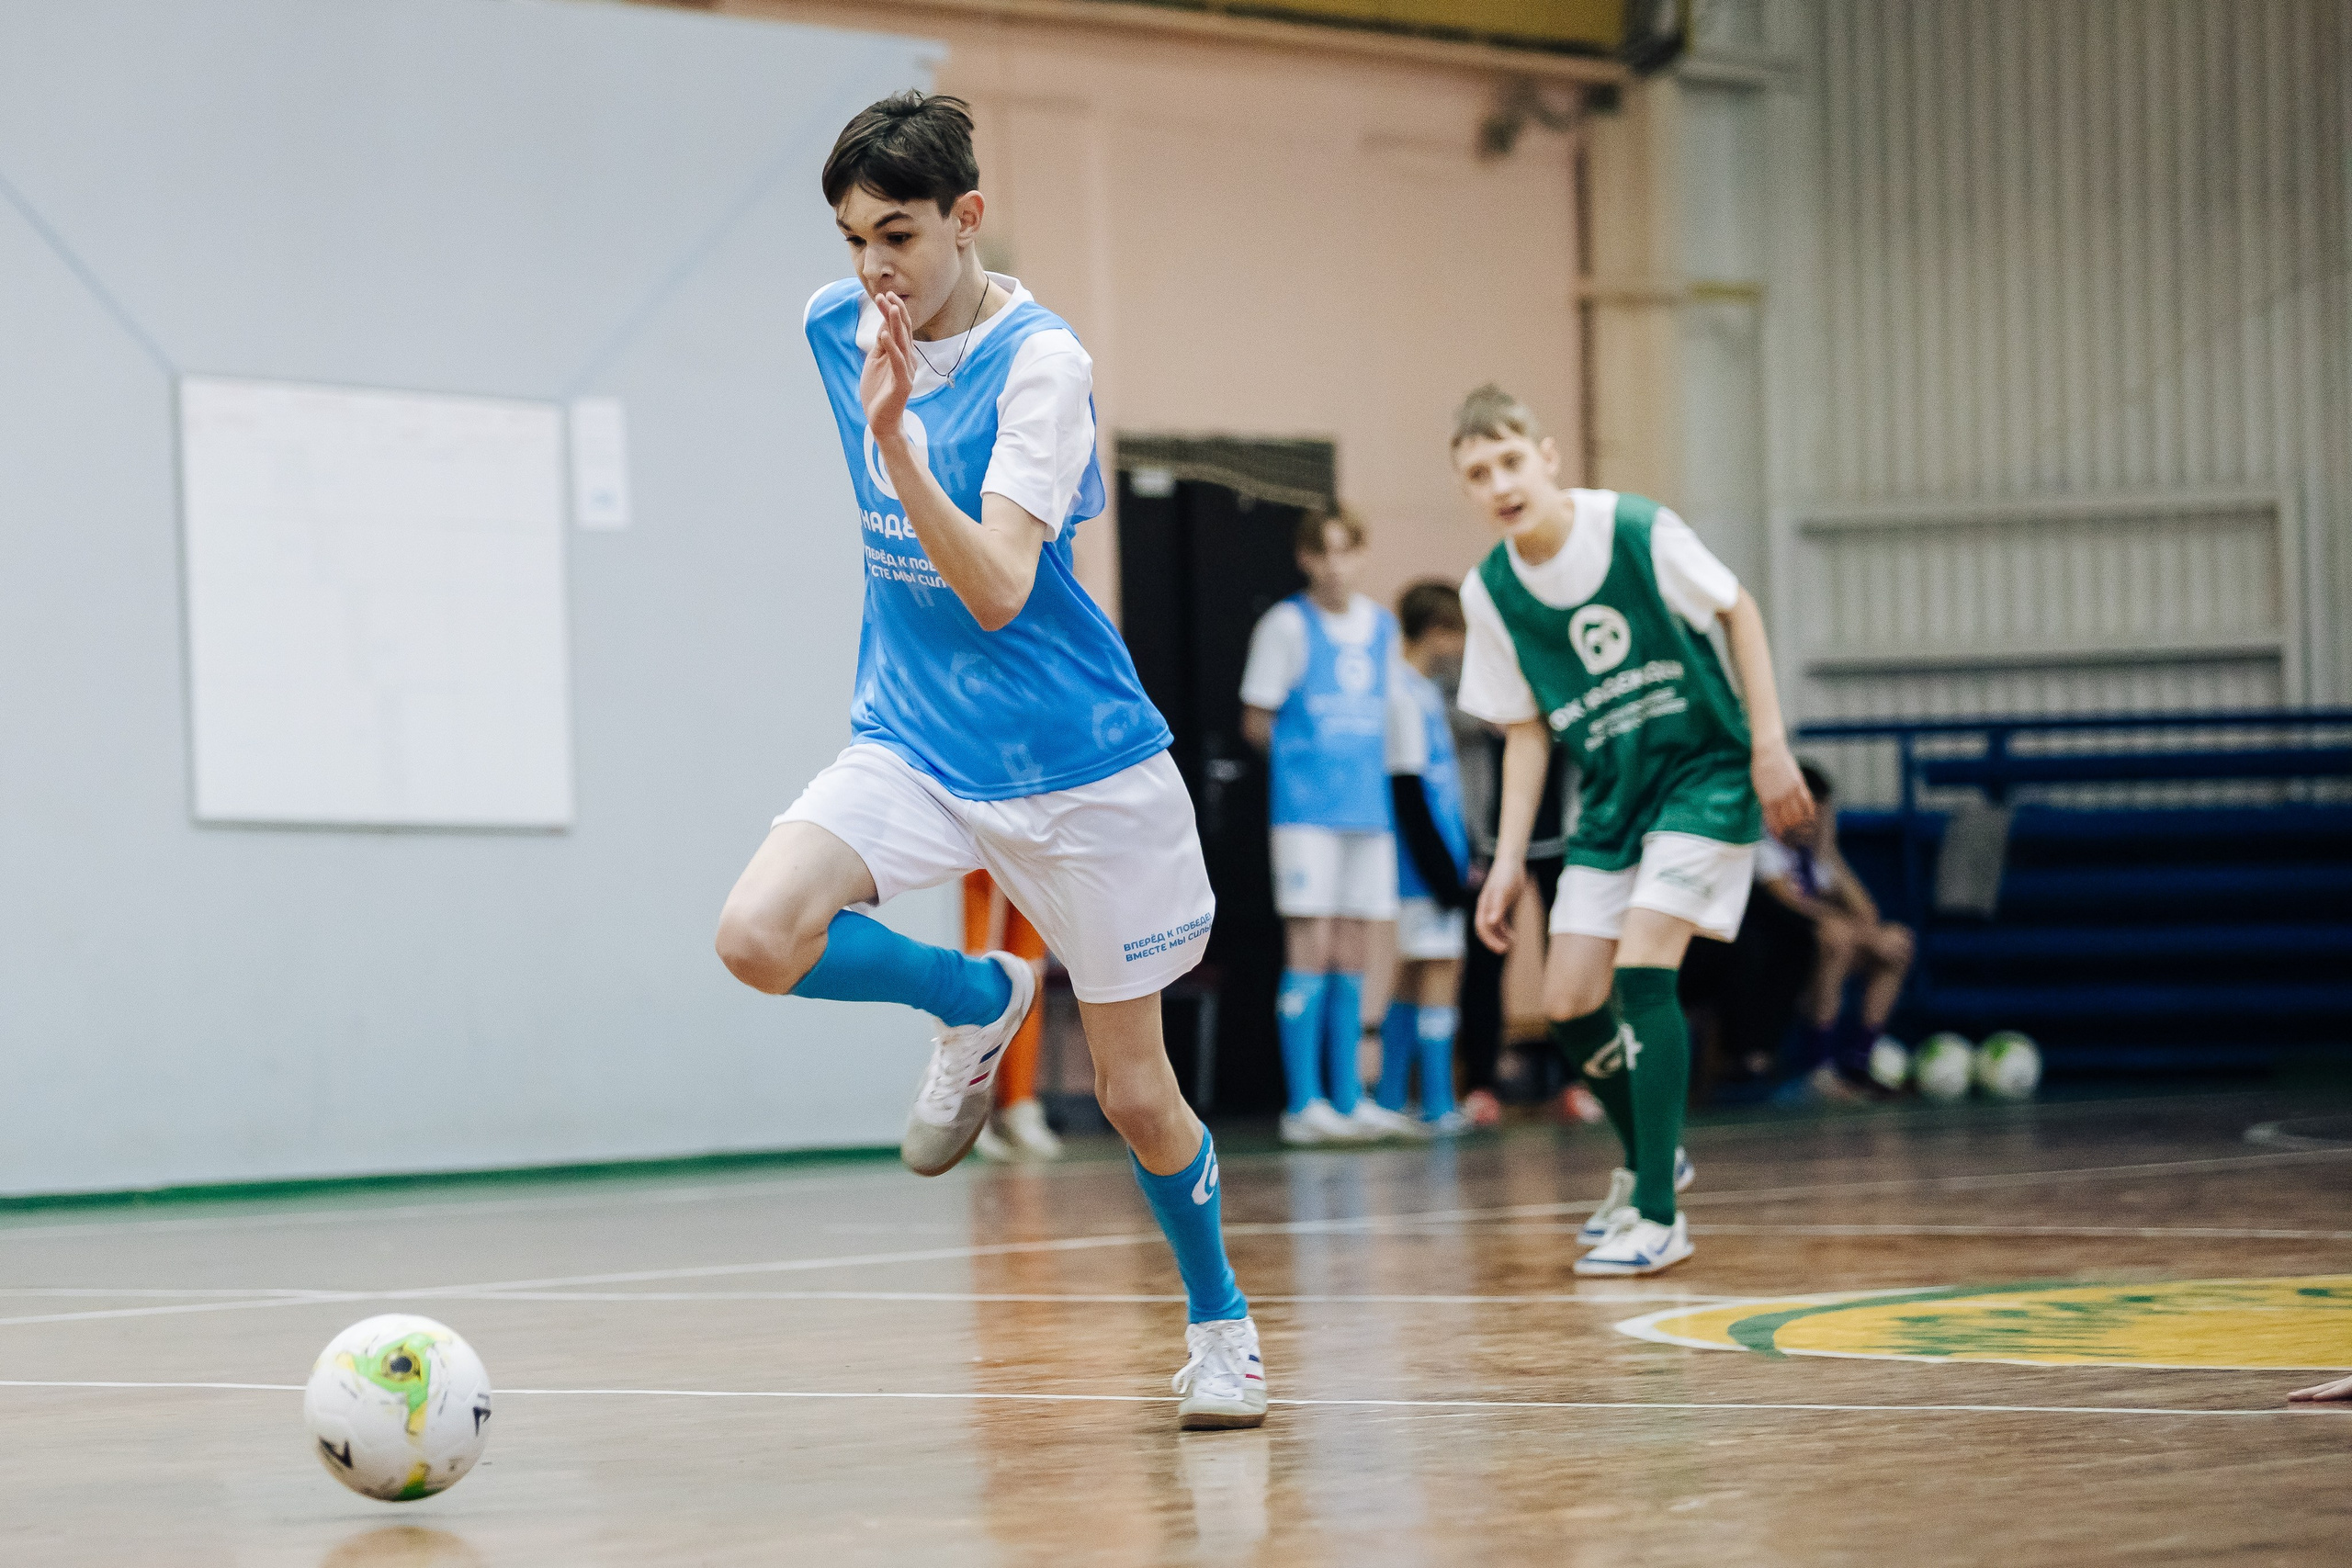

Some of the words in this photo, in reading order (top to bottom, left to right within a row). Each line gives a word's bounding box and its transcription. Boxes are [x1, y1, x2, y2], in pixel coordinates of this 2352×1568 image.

[898, 555, 908, 567] К
[892, 569, 916, 583] МЫ
[1124, 932, 1166, 952] ВПЕРЁД
[1167, 930, 1174, 938] К
[1125, 943, 1167, 962] ВМЕСТЕ
[1170, 937, 1186, 949] МЫ
